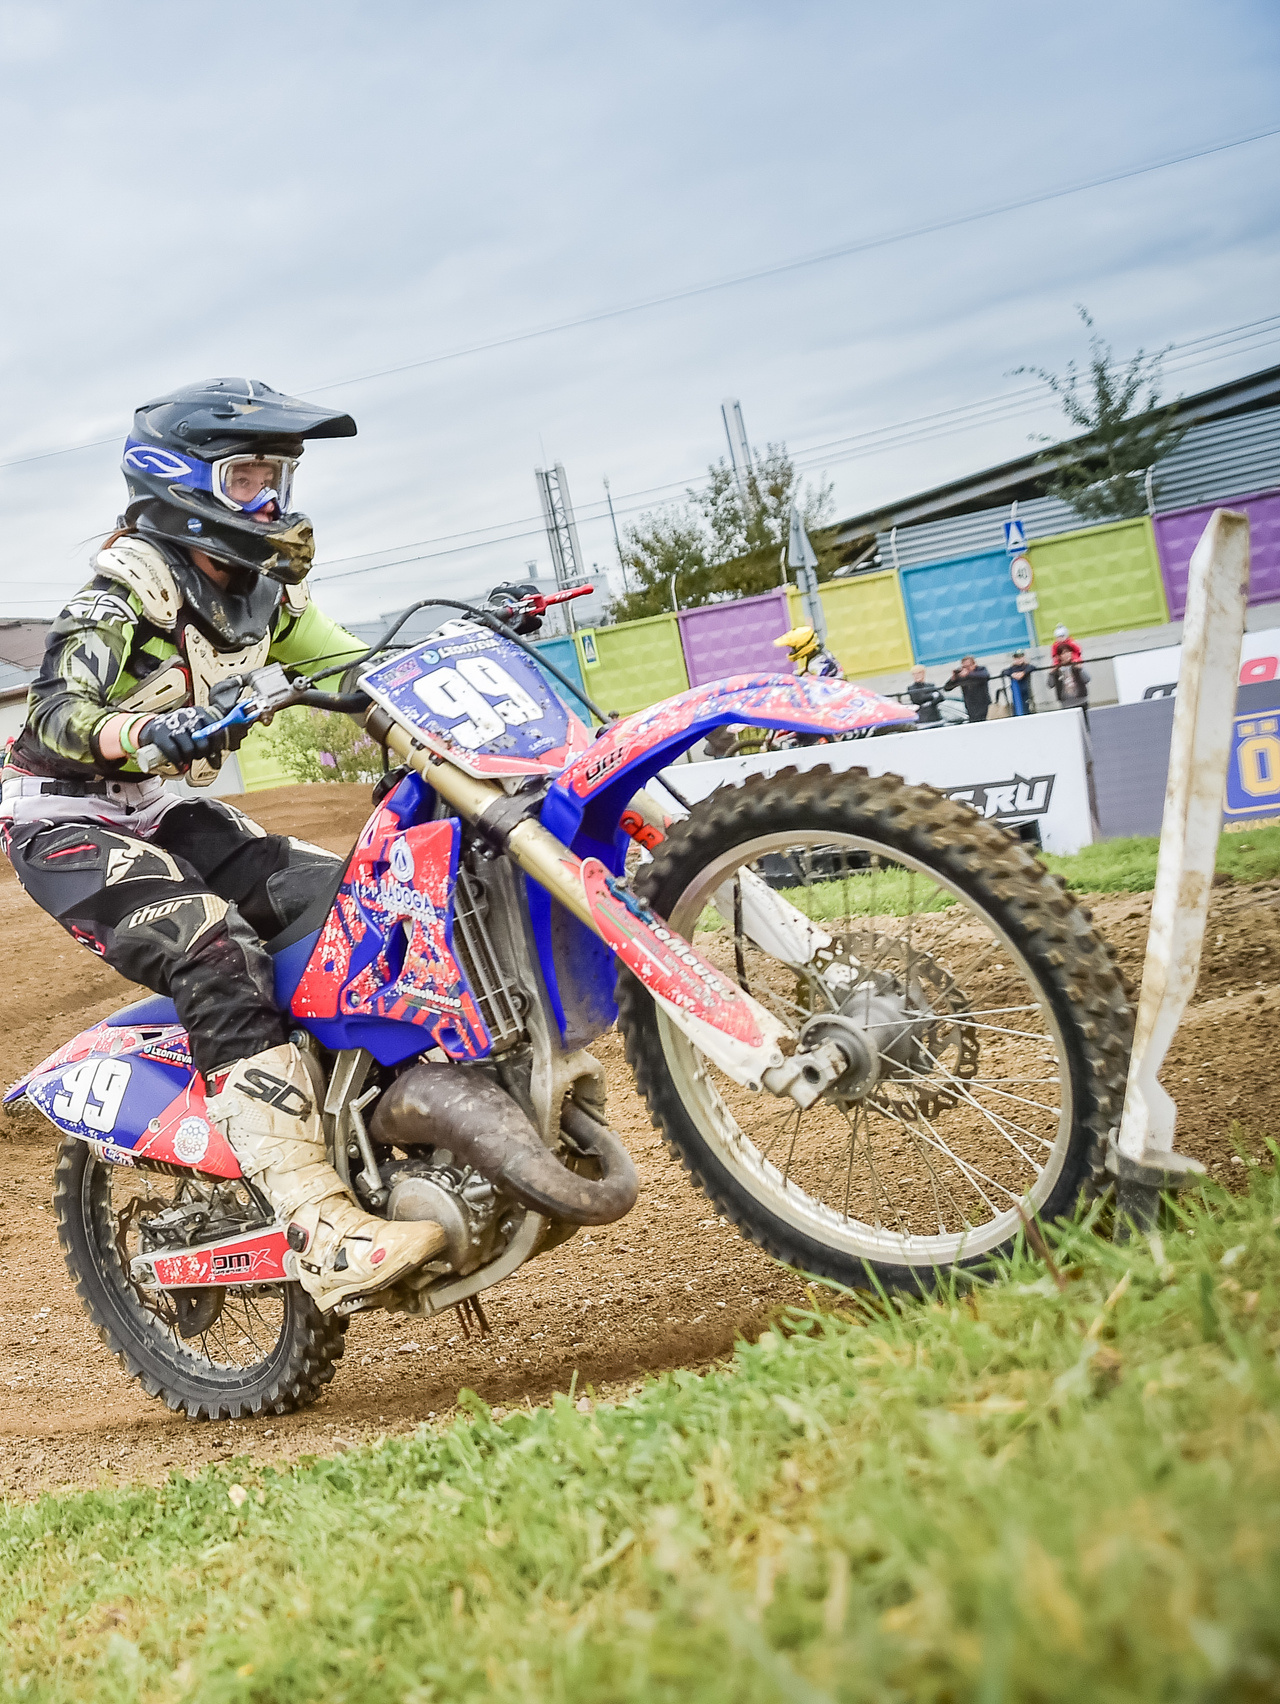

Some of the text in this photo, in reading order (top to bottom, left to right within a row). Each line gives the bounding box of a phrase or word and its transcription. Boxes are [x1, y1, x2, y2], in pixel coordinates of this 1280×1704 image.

[412, 656, 544, 750] 99
[128, 899, 193, 929] thor
[150, 1045, 194, 1065] LEONTEVA
[52, 1057, 133, 1133] 99
